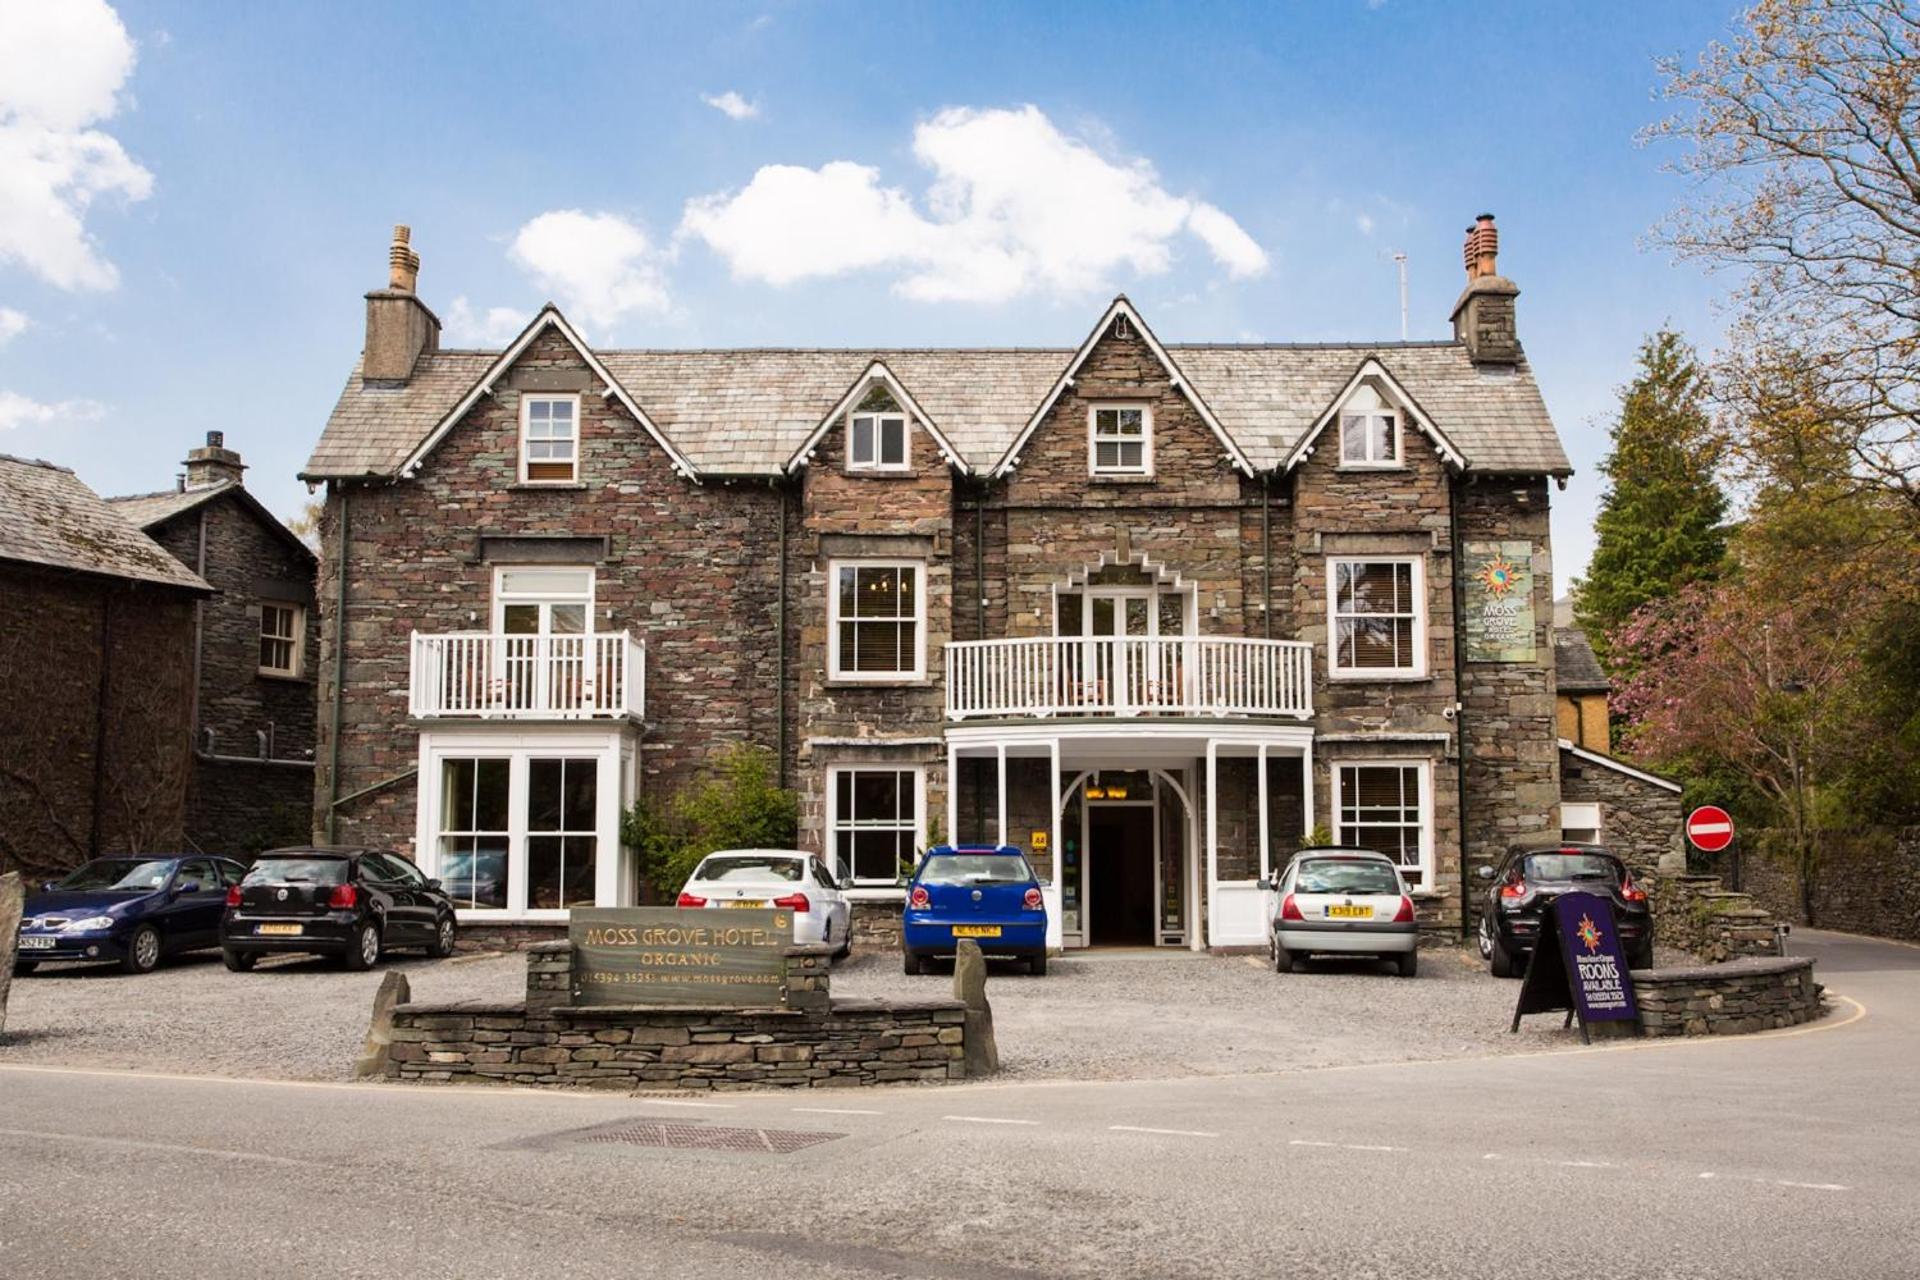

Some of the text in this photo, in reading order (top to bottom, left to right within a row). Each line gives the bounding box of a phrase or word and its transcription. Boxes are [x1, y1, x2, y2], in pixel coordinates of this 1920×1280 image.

[1484, 605, 1517, 616] MOSS
[585, 927, 778, 946] MOSS GROVE HOTEL
[641, 952, 723, 967] ORGANIC
[1578, 963, 1619, 979] ROOMS
[1583, 979, 1623, 991] AVAILABLE
